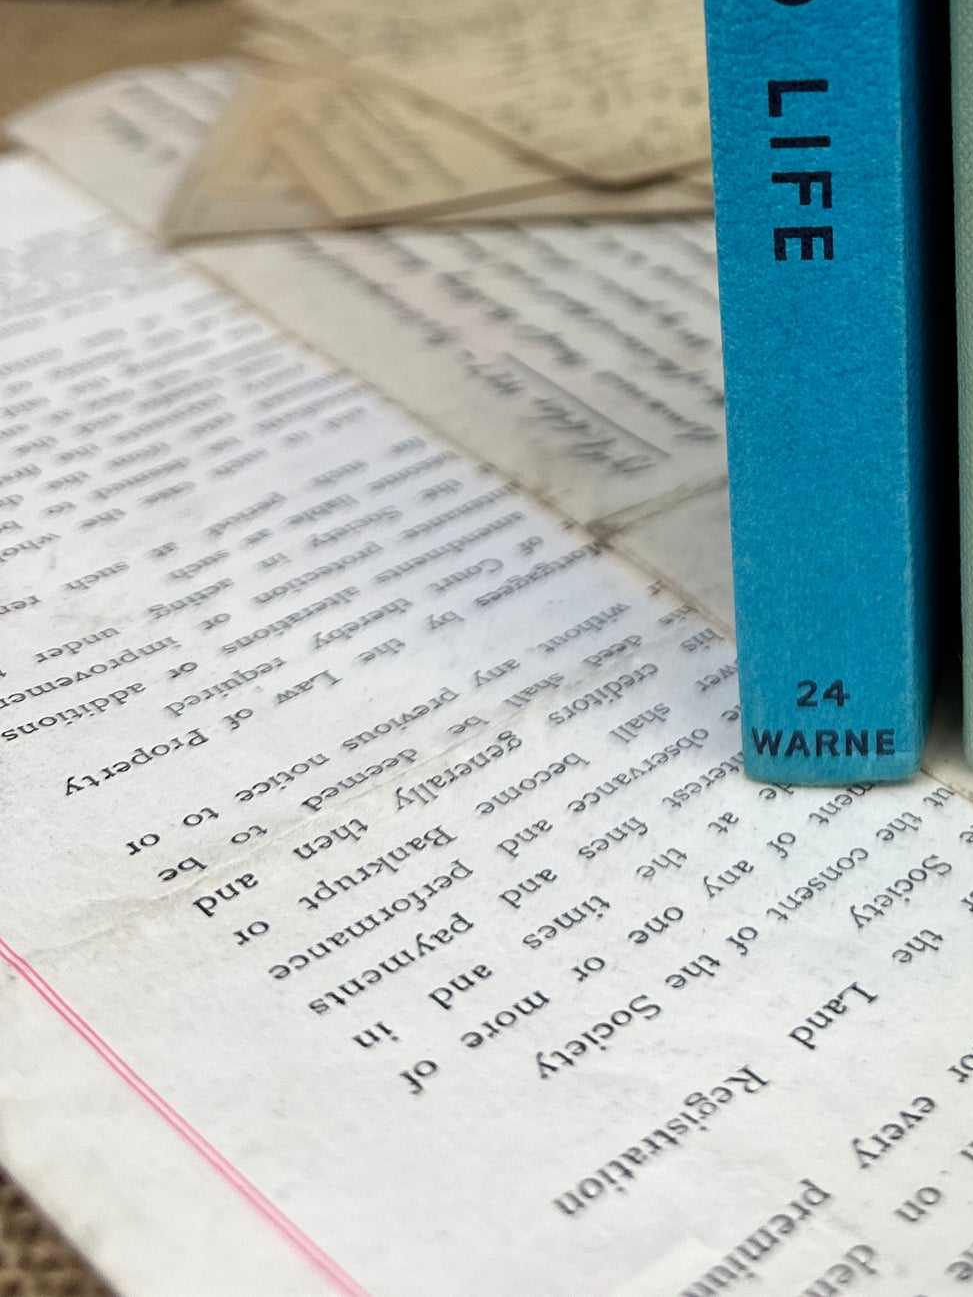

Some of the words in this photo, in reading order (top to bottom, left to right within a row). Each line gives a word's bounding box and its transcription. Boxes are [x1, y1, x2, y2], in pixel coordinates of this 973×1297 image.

[767, 79, 834, 262] LIFE
[62, 559, 130, 594] such
[251, 541, 385, 607] protection
[427, 558, 504, 594] Court
[200, 611, 231, 632] or
[219, 586, 359, 657] alterations
[312, 599, 414, 651] thereby
[427, 610, 464, 631] by
[537, 603, 630, 655] without
[34, 627, 121, 664] under
[357, 637, 406, 666] the
[583, 637, 641, 667] deed
[163, 656, 287, 719] required
[167, 660, 198, 680] or
[275, 669, 344, 706] Law
[473, 658, 521, 689] any
[503, 673, 563, 709] shall
[696, 658, 738, 694] wer
[0, 682, 147, 743] additions
[547, 663, 659, 727] creditors
[796, 679, 851, 707] 24
[221, 708, 254, 733] of
[342, 687, 459, 752] previous
[442, 715, 491, 755] be
[609, 702, 671, 745] shall
[63, 727, 210, 797] Property
[751, 727, 897, 758] WARNE
[235, 753, 330, 803] notice
[301, 748, 418, 813] deemed
[394, 731, 522, 812] generally
[474, 752, 591, 817] become
[566, 728, 710, 816] observance
[181, 806, 220, 829] to
[228, 824, 269, 846] to
[707, 811, 740, 836] at
[875, 809, 920, 843] the
[125, 832, 161, 857] or
[291, 818, 369, 861] then
[496, 818, 554, 863] and
[576, 816, 649, 863] fines
[766, 831, 797, 862] of
[156, 856, 209, 887] be
[297, 824, 459, 912] Bankrupt
[635, 847, 688, 883] the
[702, 859, 755, 901] any
[766, 846, 868, 921] consent
[191, 872, 259, 919] and
[497, 868, 558, 911] and
[849, 853, 953, 932] Society
[231, 920, 271, 948] or
[267, 857, 474, 982] performance
[521, 894, 611, 951] times
[627, 906, 685, 947] one
[724, 925, 759, 958] of
[891, 928, 945, 965] the
[307, 911, 475, 1017] payments
[570, 956, 605, 983] or
[664, 953, 722, 991] the
[427, 964, 494, 1012] and
[351, 1020, 400, 1050] in
[459, 989, 551, 1051] more
[535, 993, 663, 1081] Society
[787, 980, 881, 1052] Land
[397, 1059, 440, 1097] of
[551, 1063, 772, 1219] Registration
[850, 1095, 938, 1170] every
[893, 1186, 944, 1225] on
